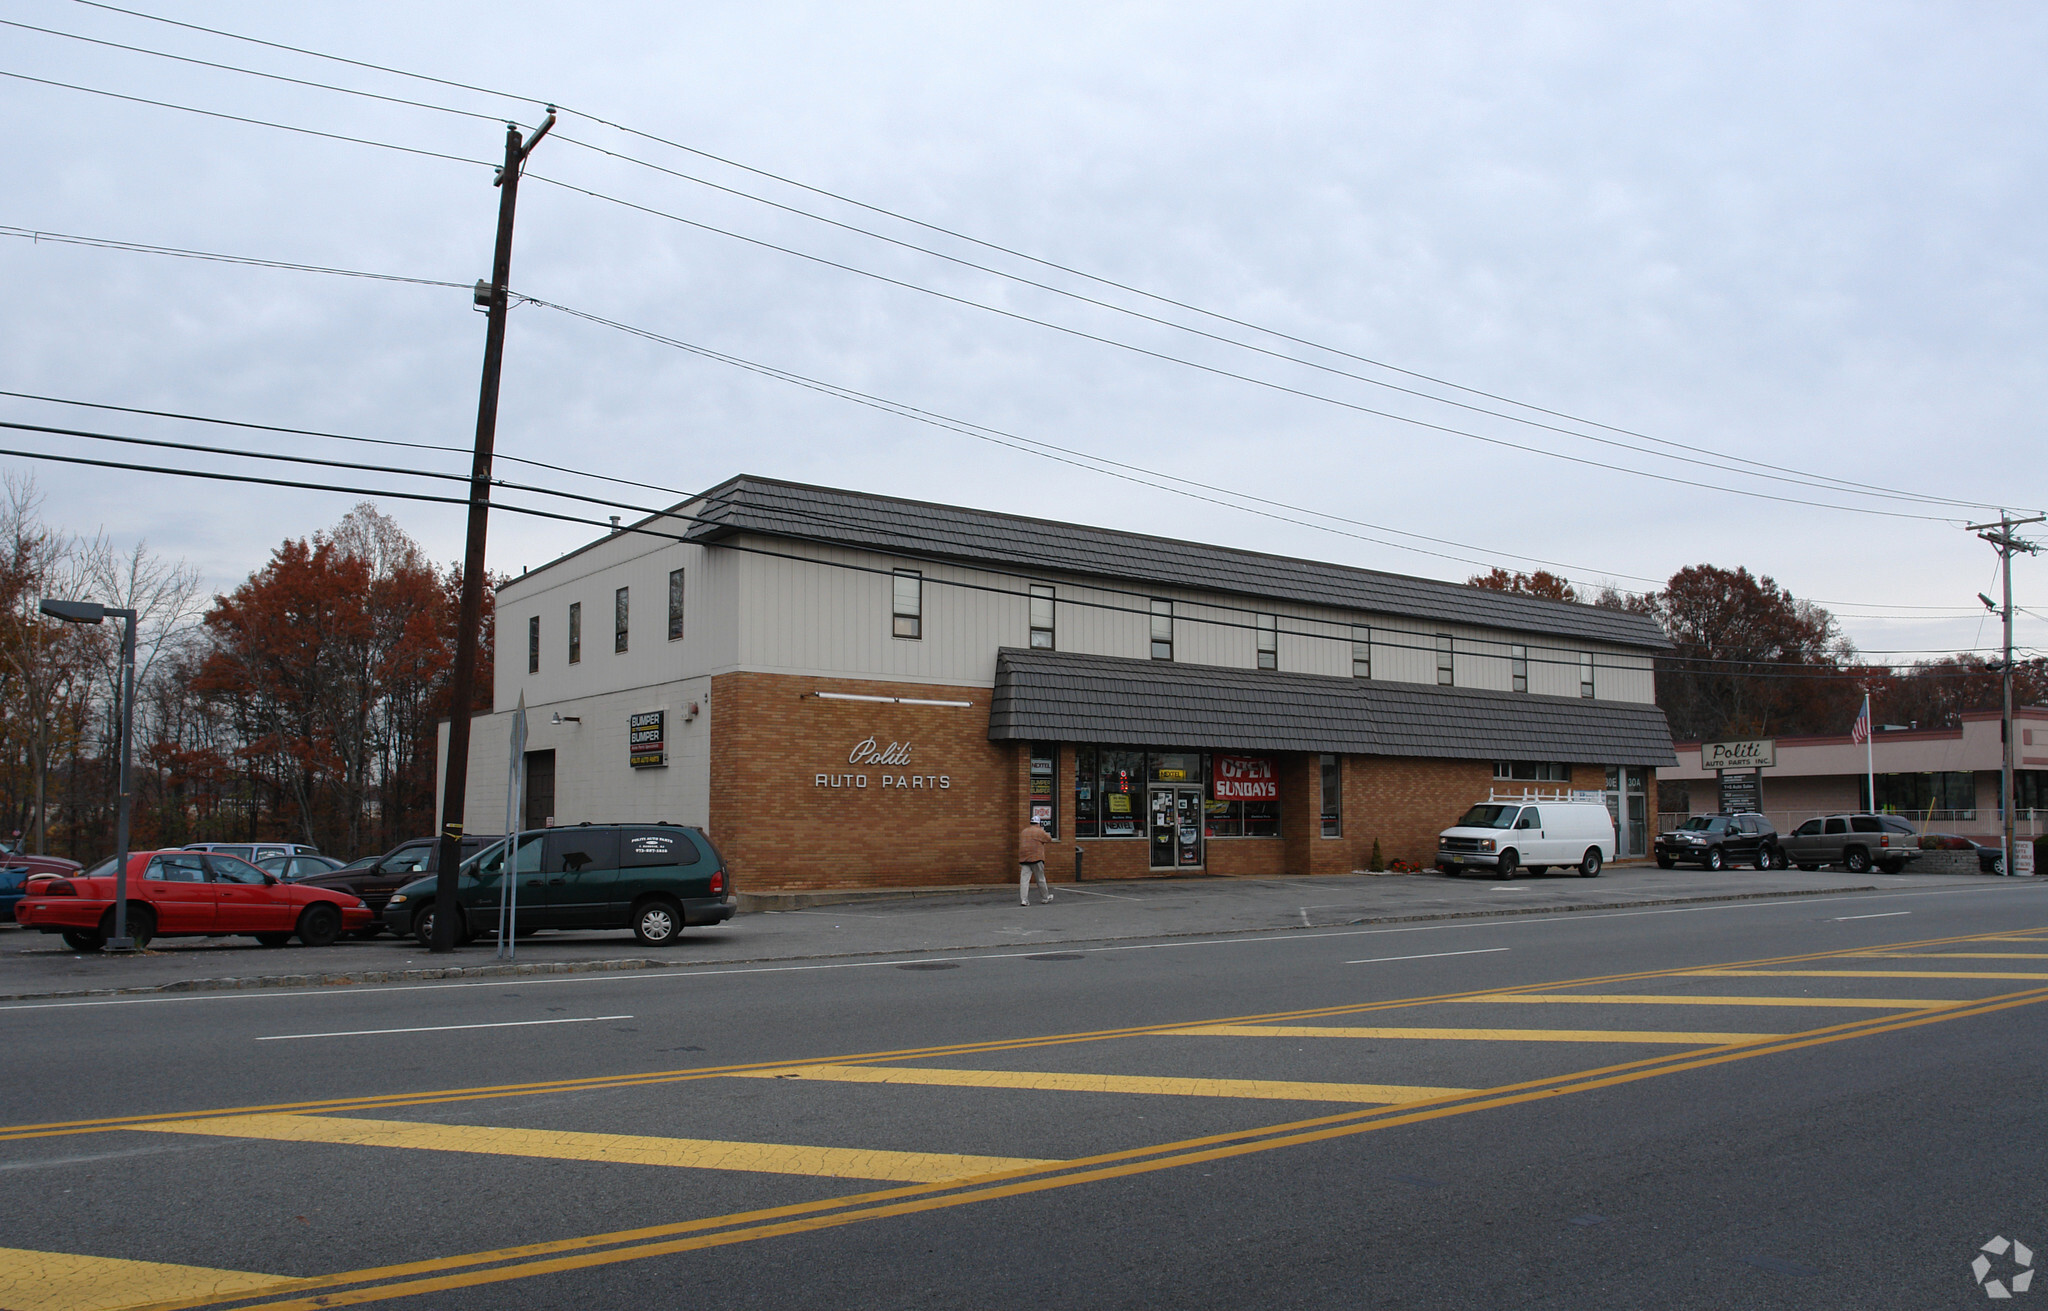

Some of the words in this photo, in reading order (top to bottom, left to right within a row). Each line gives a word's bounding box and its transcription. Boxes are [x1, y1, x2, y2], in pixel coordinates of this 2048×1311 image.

[631, 713, 659, 727] BUMPER
[631, 730, 659, 743] BUMPER
[849, 736, 912, 766] Politi
[1713, 742, 1761, 759] Politi
[1221, 758, 1271, 778] OPEN
[815, 774, 867, 788] AUTO
[882, 775, 950, 789] PARTS
[1216, 780, 1276, 797] SUNDAYS
[1106, 821, 1133, 830] NEXTEL
